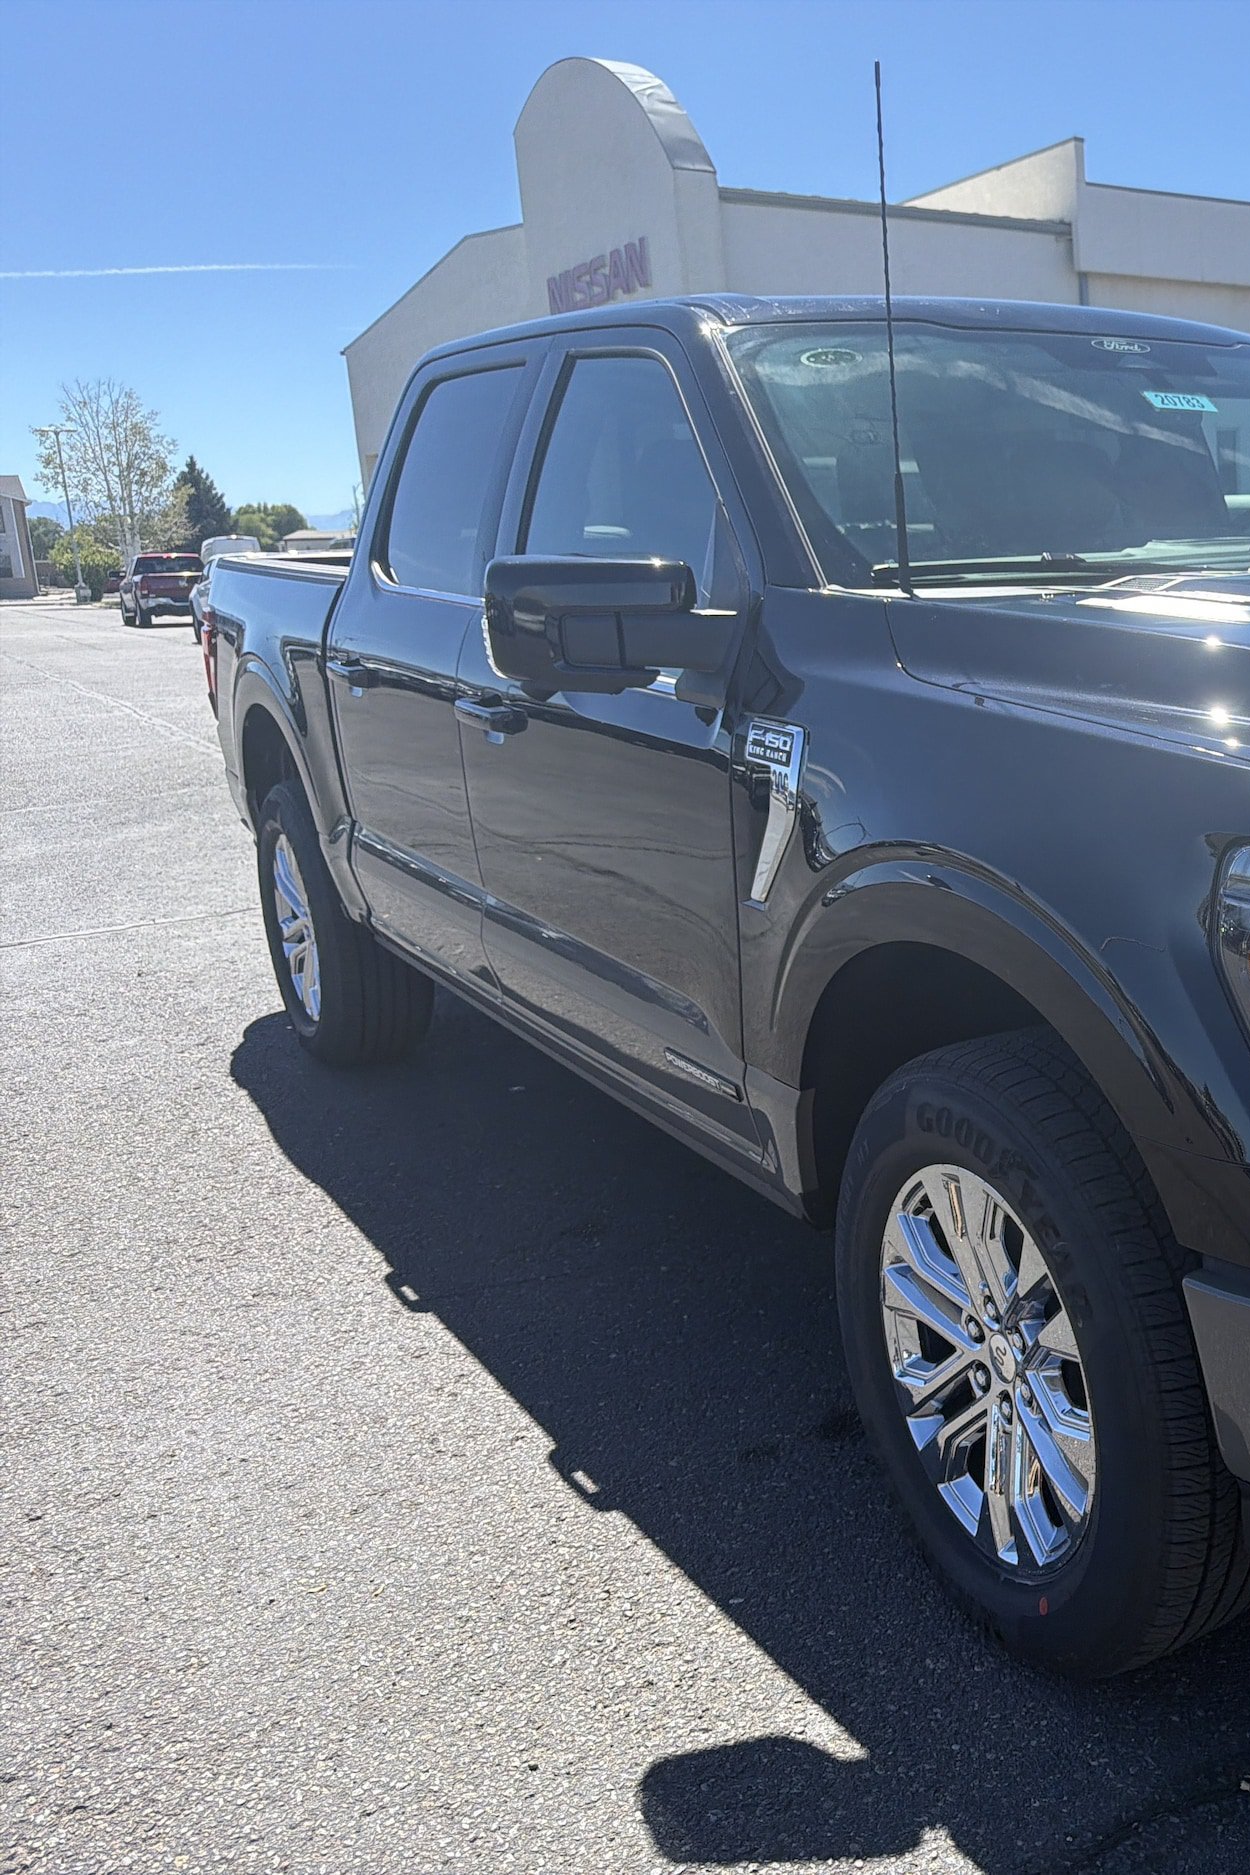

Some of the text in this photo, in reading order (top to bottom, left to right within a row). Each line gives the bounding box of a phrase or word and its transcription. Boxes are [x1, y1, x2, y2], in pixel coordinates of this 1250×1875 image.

[547, 236, 652, 315] NISSAN
[1102, 340, 1142, 353] Ford
[1155, 393, 1206, 410] 20783
[749, 728, 791, 751] F-150
[766, 749, 787, 762] RANCH
